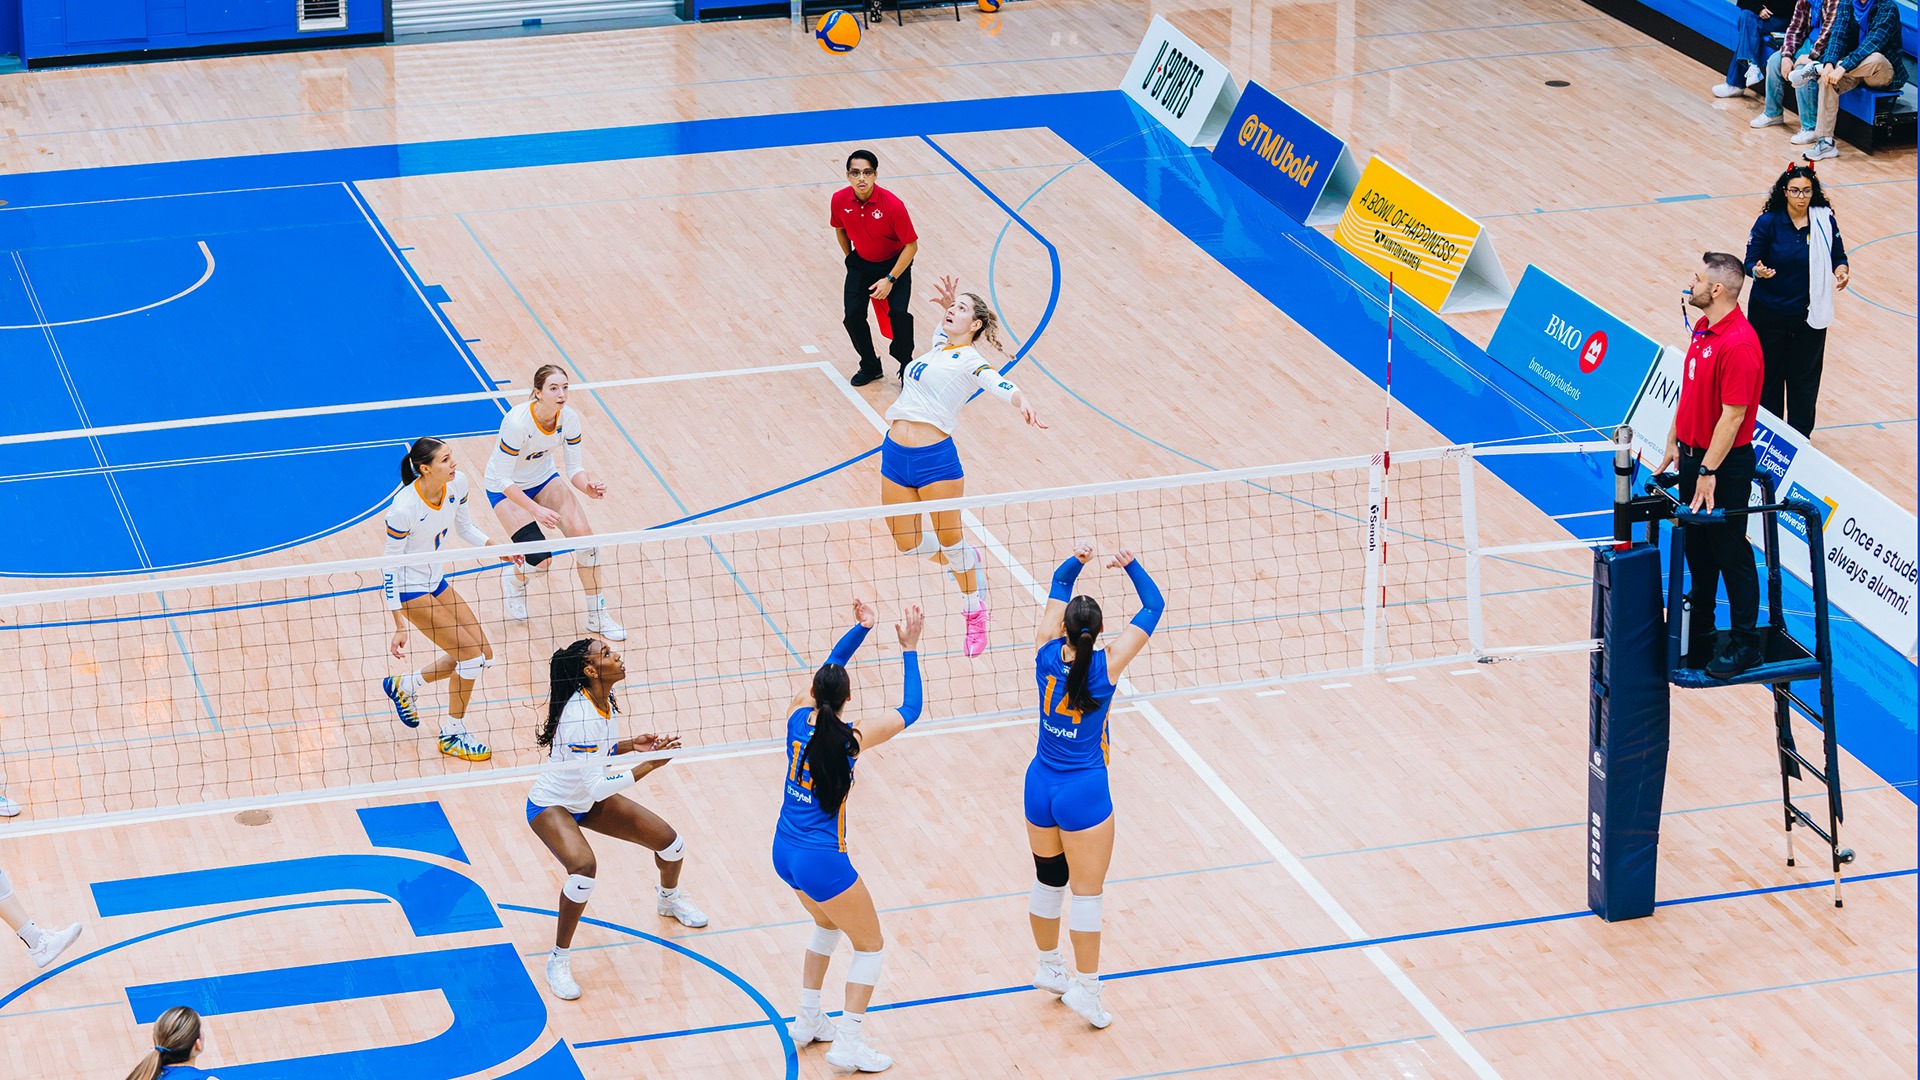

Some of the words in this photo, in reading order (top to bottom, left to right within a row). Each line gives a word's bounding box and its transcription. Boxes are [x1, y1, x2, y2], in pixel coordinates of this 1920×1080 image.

[1142, 40, 1169, 90] U
[1151, 47, 1204, 119] SPORTS
[1238, 114, 1319, 188] @TMUbold
[1359, 189, 1373, 207] A
[1366, 192, 1396, 222] BOWL
[1391, 209, 1409, 229] OF
[1401, 217, 1459, 264] HAPPINESS!
[1381, 236, 1404, 259] KINTON
[1400, 248, 1422, 270] RAMEN
[1544, 313, 1582, 350] BMO
[909, 361, 928, 381] 18
[1528, 356, 1581, 400] bmo.com/students
[1761, 455, 1785, 478] Express
[1767, 444, 1785, 463] Holiday
[1369, 515, 1378, 552] Senoh
[1842, 517, 1874, 551] Once
[1873, 543, 1884, 558] a
[1827, 546, 1869, 583] always
[1867, 575, 1912, 616] alumni.
